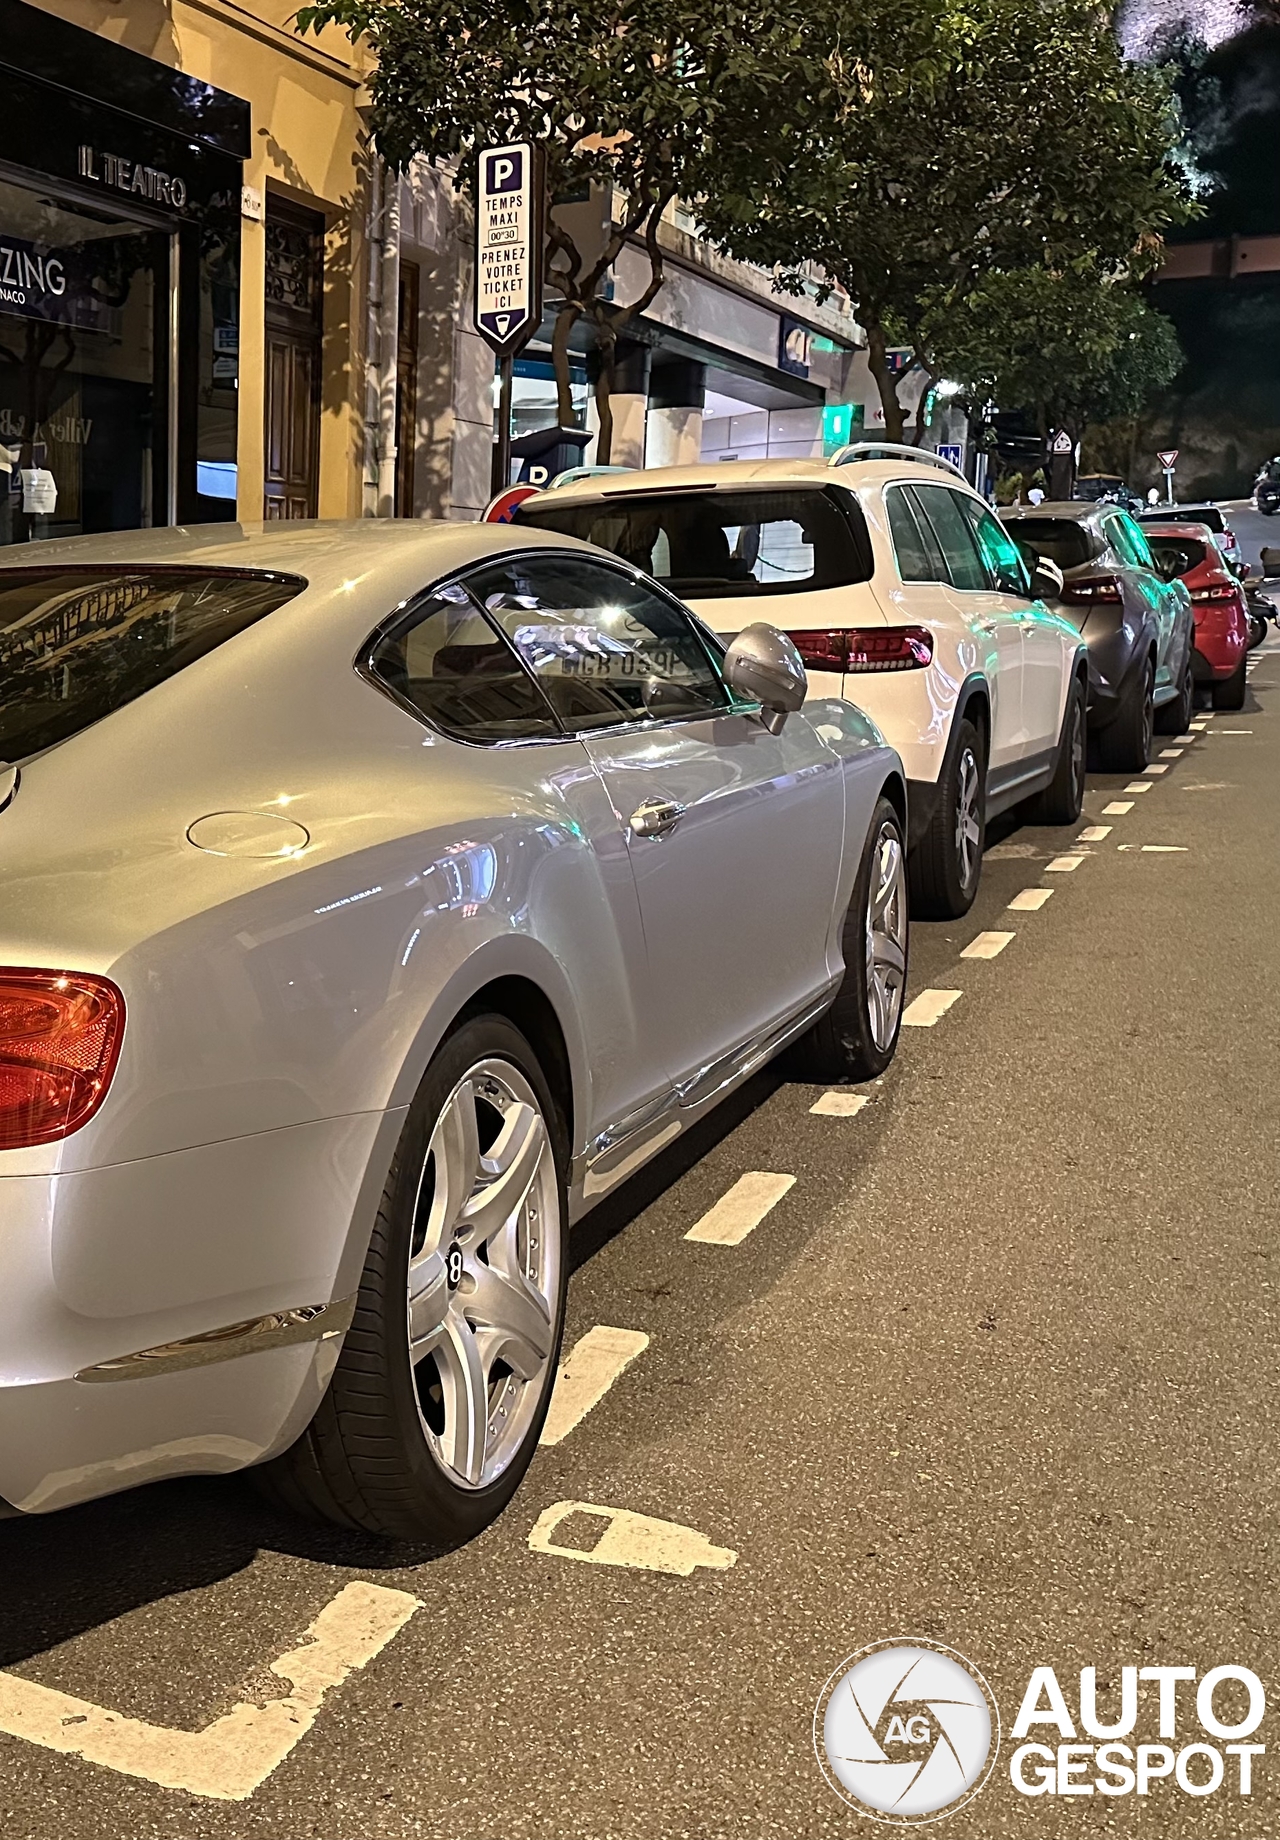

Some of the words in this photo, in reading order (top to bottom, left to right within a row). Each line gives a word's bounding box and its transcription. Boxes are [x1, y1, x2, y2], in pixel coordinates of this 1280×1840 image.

[79, 145, 99, 180] IL
[101, 152, 186, 207] TEATRO
[494, 159, 514, 189] P
[486, 195, 523, 212] TEMPS
[490, 211, 518, 227] MAXI
[481, 248, 525, 265] PRENEZ
[486, 263, 521, 279] VOTRE
[483, 278, 523, 295] TICKET
[495, 296, 511, 309] ICI
